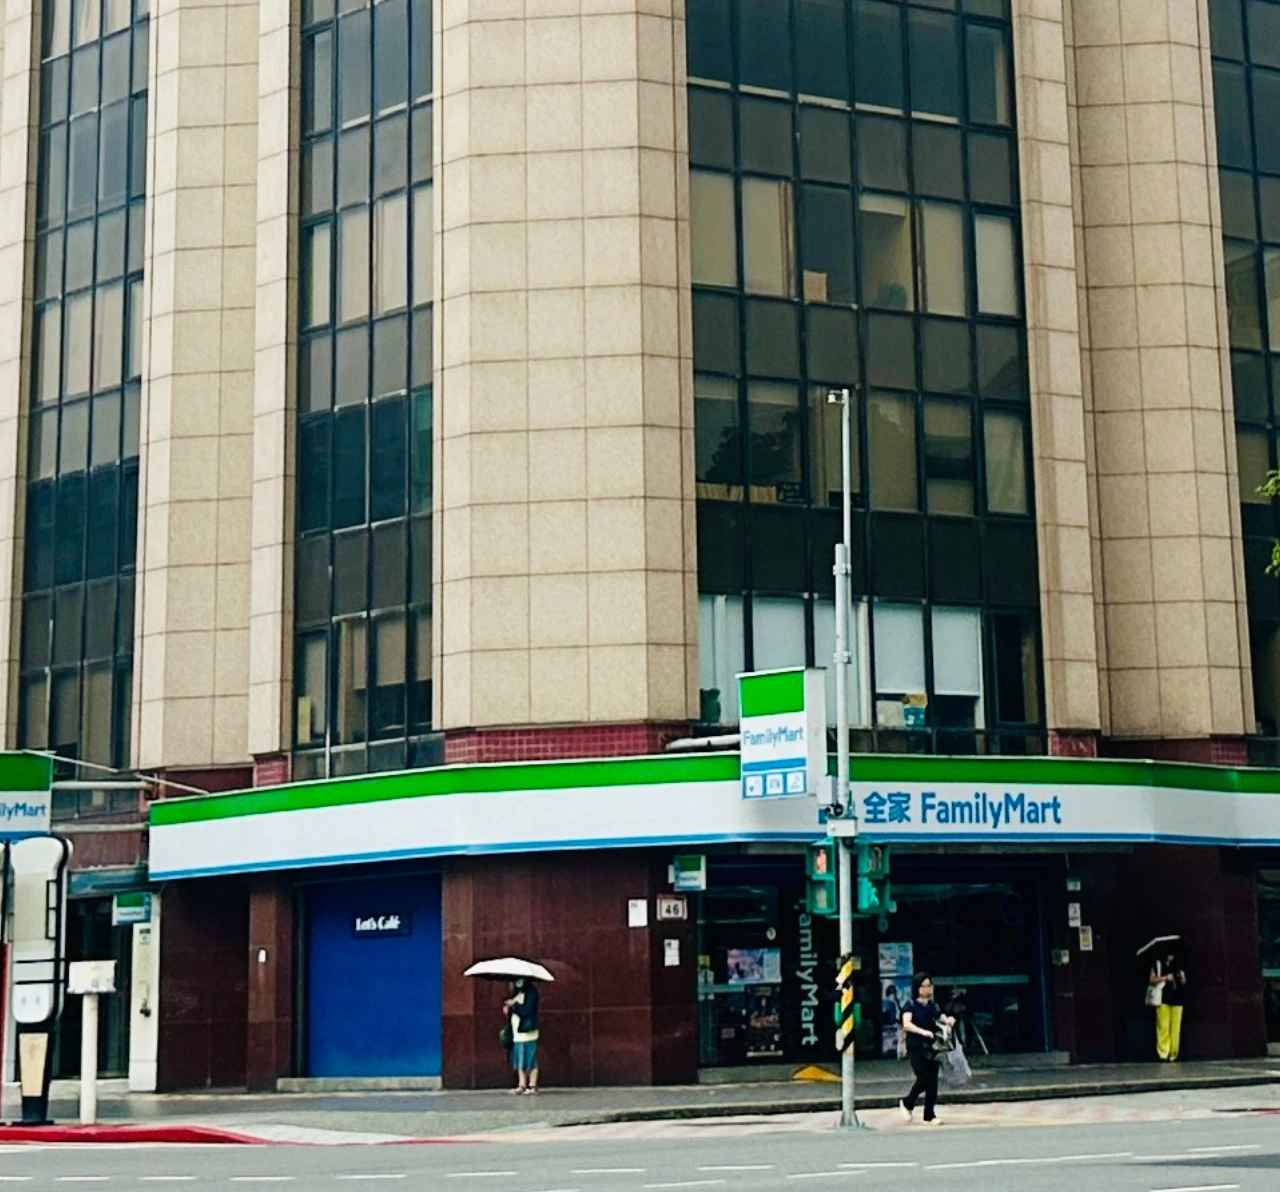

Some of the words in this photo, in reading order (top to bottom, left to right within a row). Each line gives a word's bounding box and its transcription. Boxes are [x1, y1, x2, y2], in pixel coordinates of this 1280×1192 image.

[743, 726, 804, 749] FamilyMart
[863, 791, 911, 824] 全家
[920, 791, 1062, 829] FamilyMart
[665, 903, 679, 915] 46
[796, 898, 819, 1046] amilyMart
